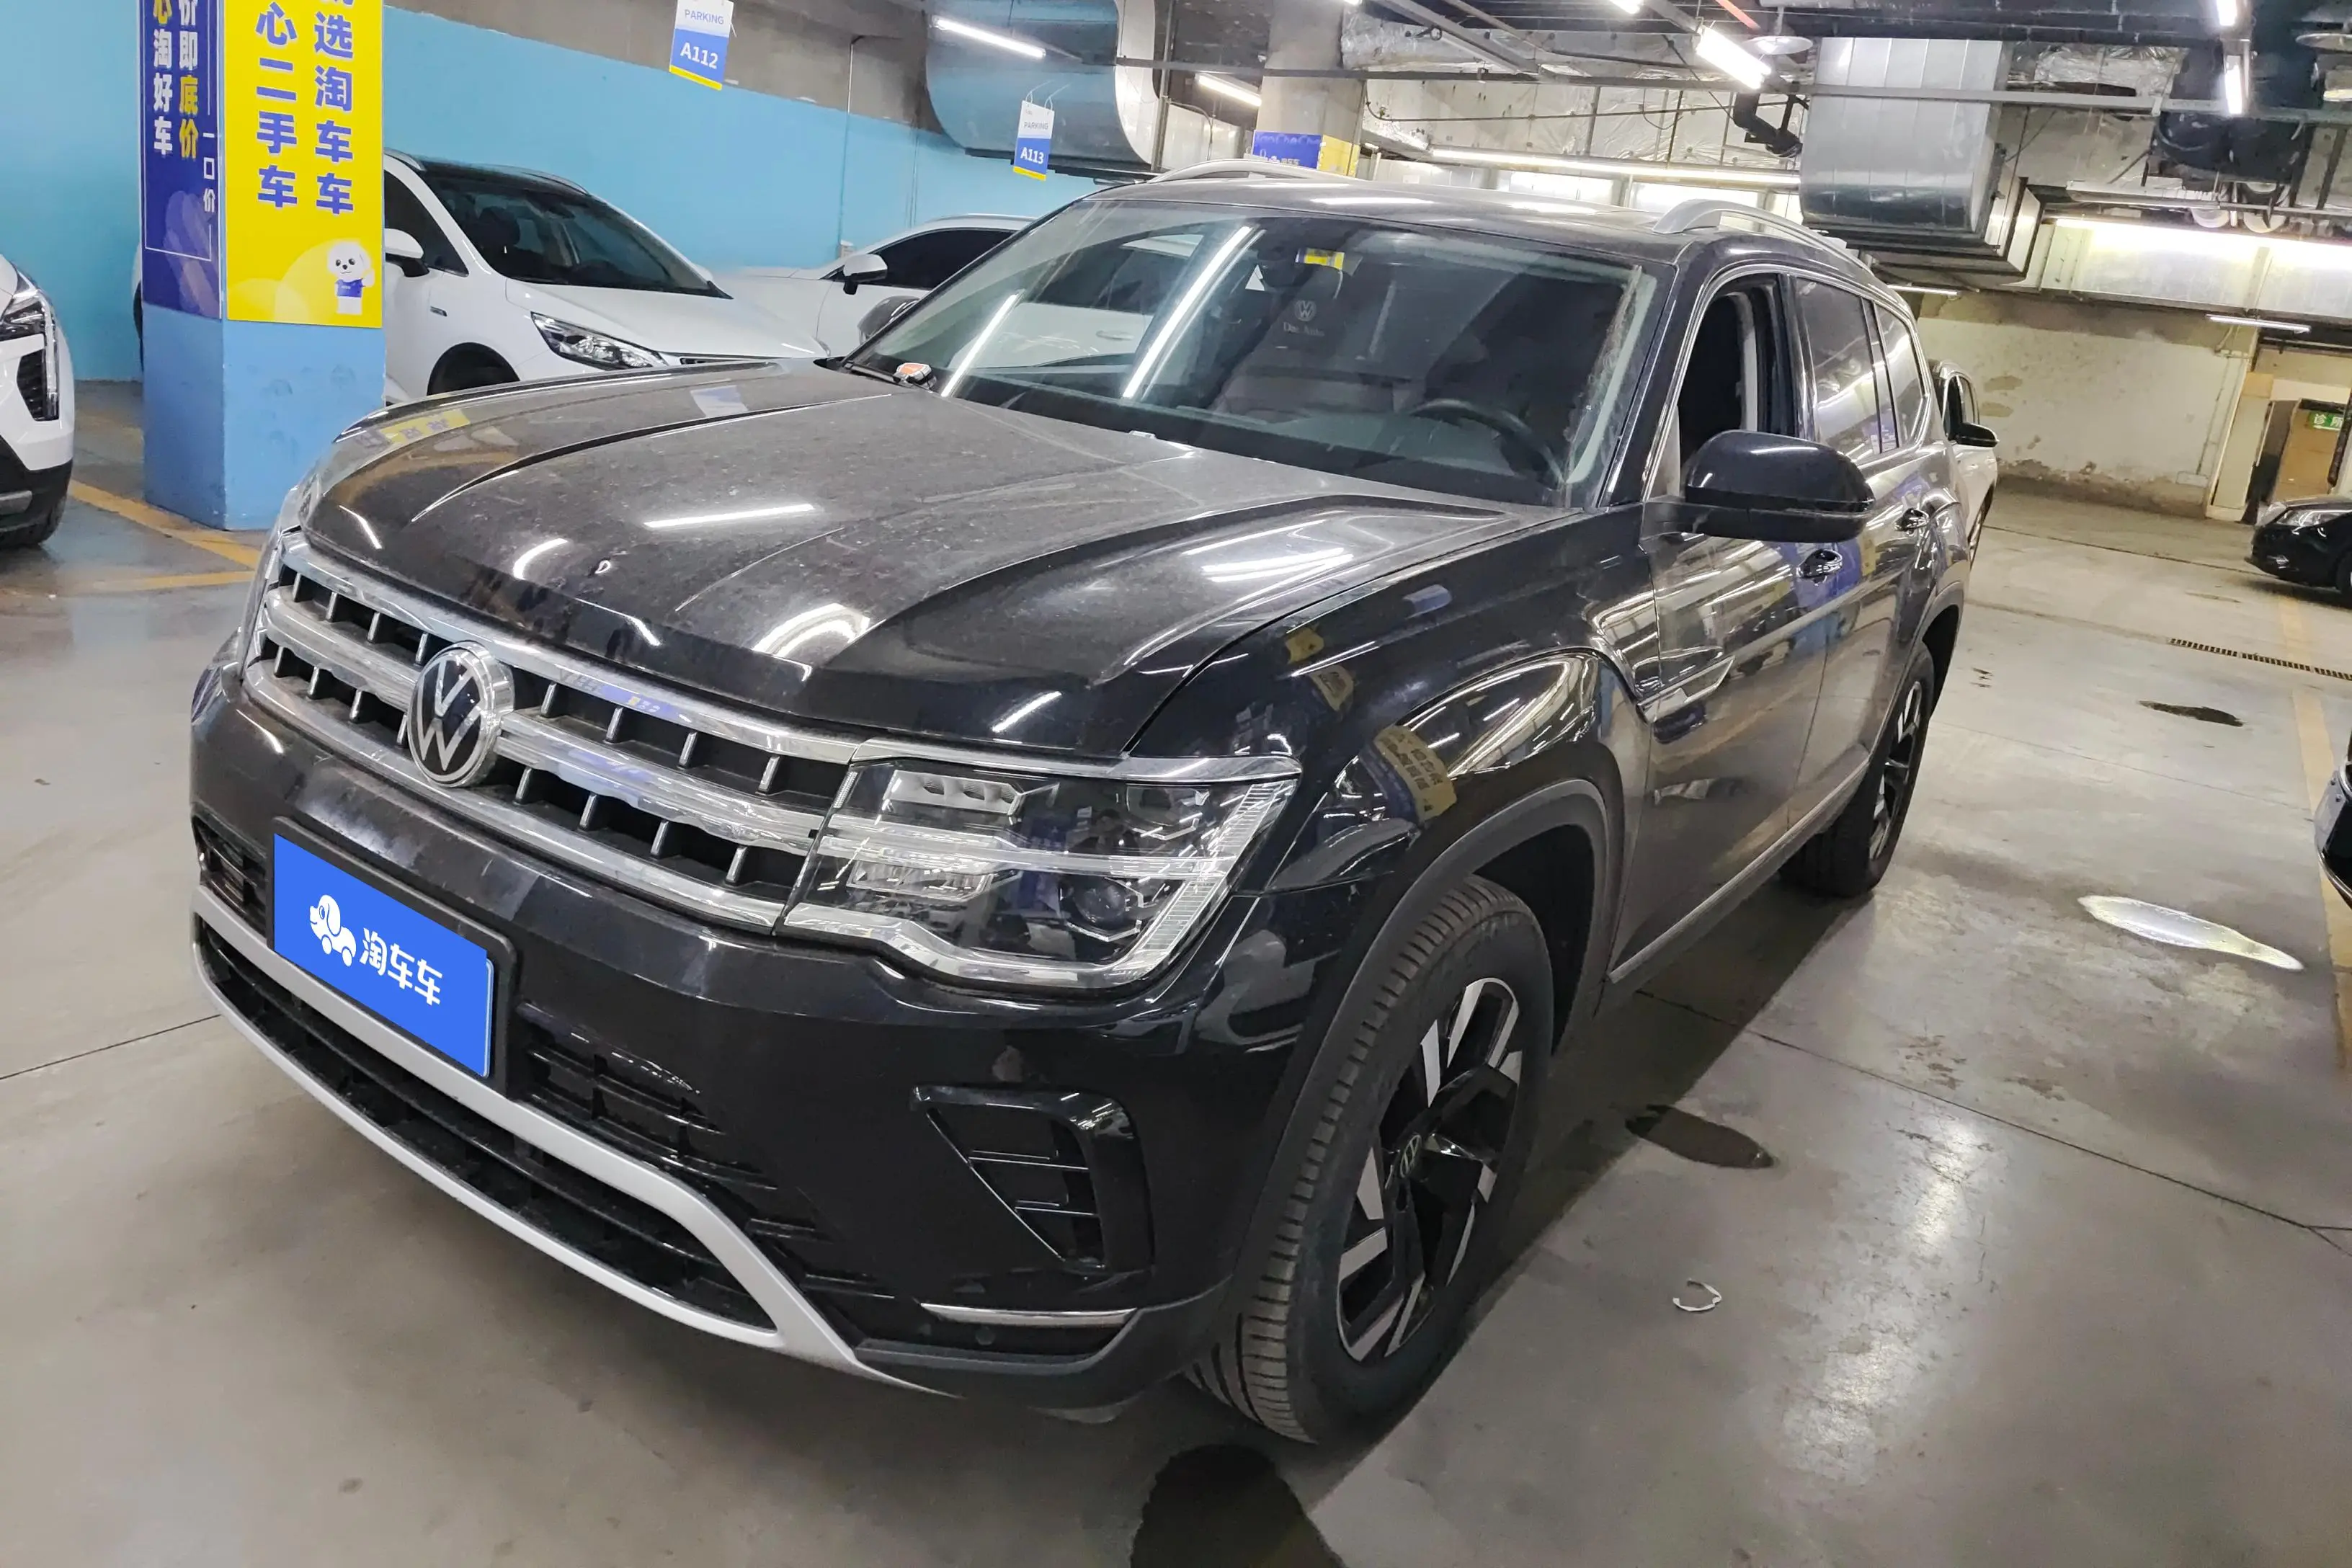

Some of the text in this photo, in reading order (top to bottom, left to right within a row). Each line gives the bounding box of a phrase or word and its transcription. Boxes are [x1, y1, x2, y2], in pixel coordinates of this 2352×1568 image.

[684, 9, 724, 24] PARKING
[179, 0, 199, 160] 价即底价
[680, 43, 718, 69] A112
[256, 1, 298, 208] 心二手车
[314, 0, 354, 215] 选淘车车
[1024, 121, 1049, 130] PARKING
[202, 132, 215, 213] 一口价
[1020, 147, 1044, 164] A113
